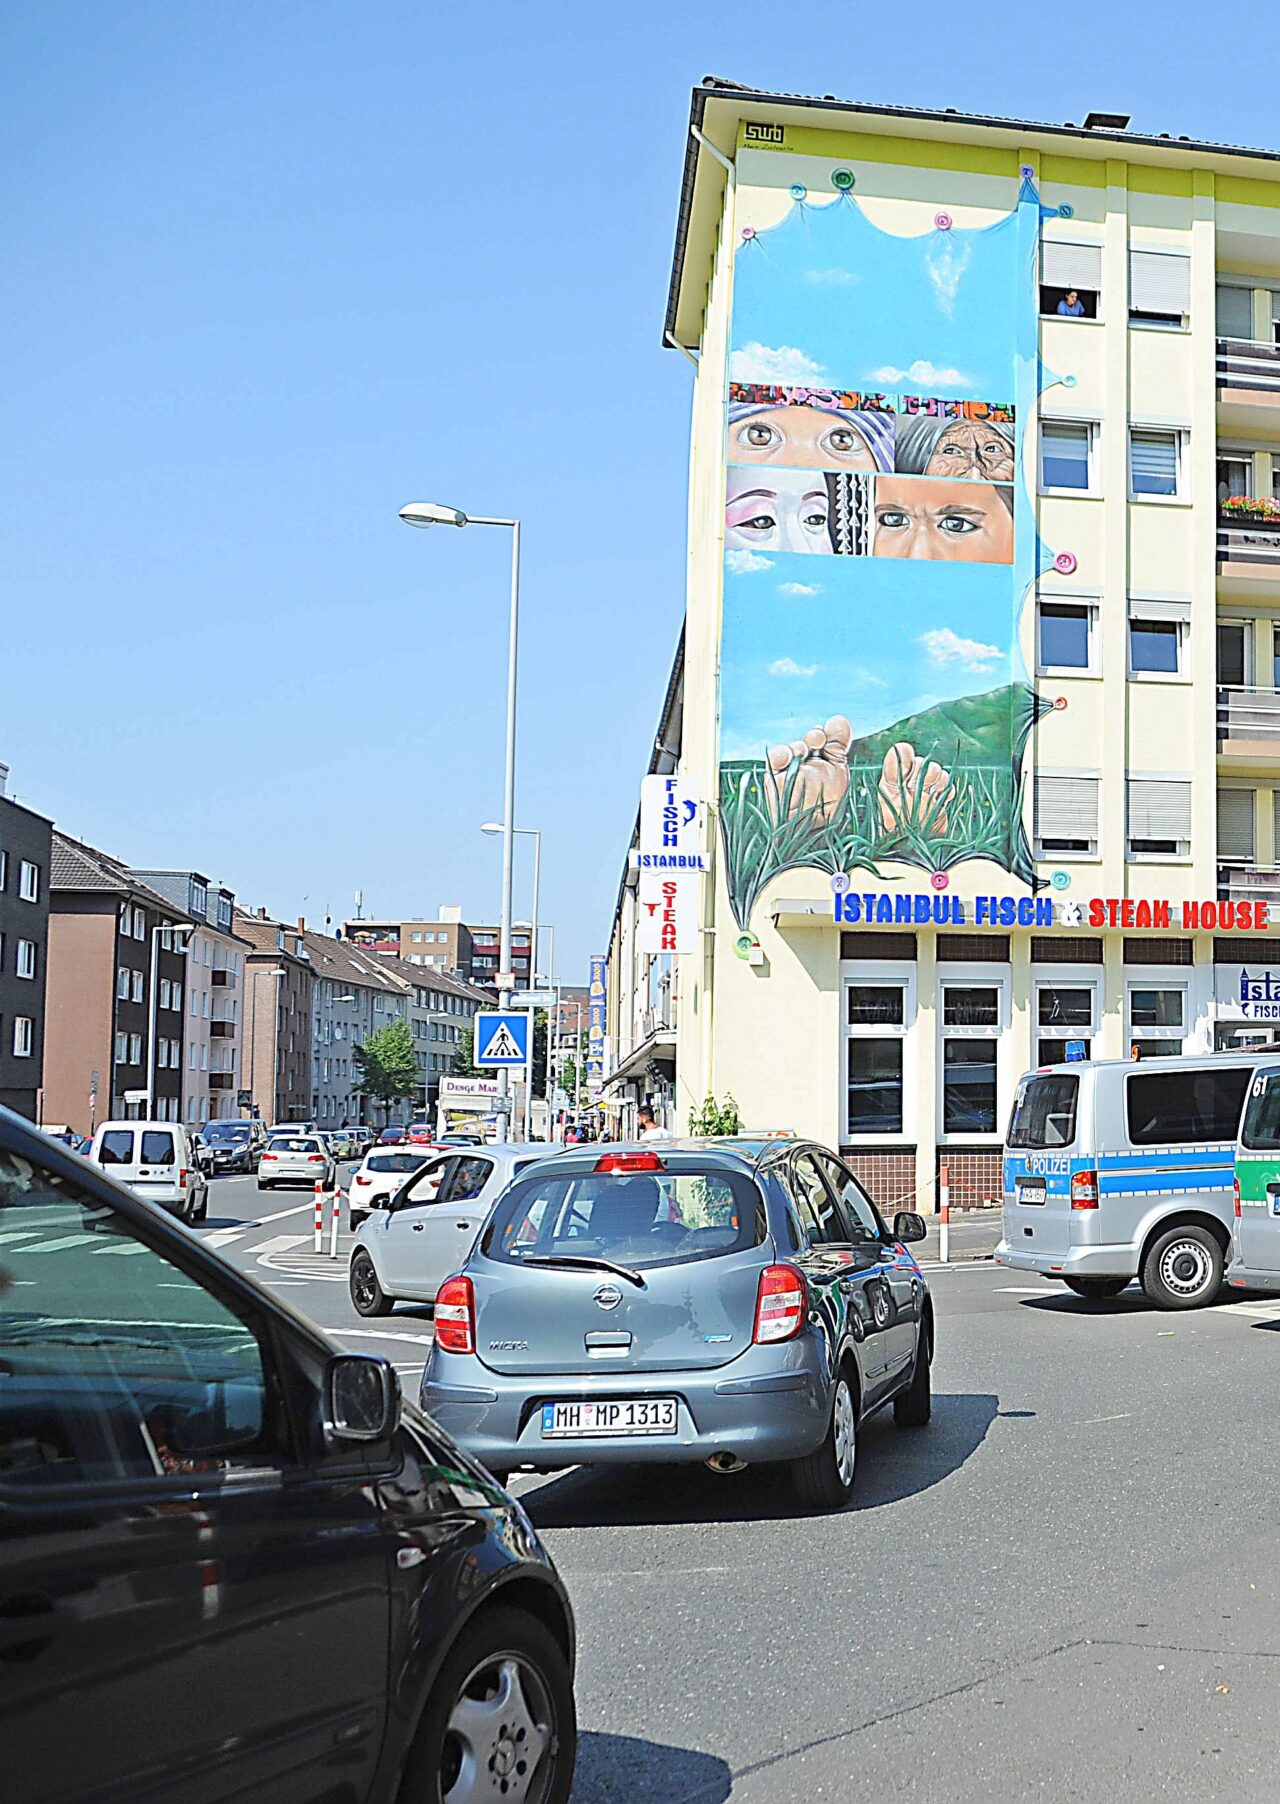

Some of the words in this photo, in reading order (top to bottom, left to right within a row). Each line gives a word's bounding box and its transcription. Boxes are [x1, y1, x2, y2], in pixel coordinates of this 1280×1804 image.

[663, 779, 678, 847] FISCH
[637, 854, 704, 869] ISTANBUL
[661, 881, 678, 950] STEAK
[975, 895, 1052, 927] FISCH
[1088, 898, 1171, 929] STEAK
[1182, 901, 1269, 930] HOUSE
[1252, 1075, 1269, 1097] 61
[1032, 1158, 1071, 1176] POLIZEI
[489, 1340, 530, 1351] MICRA
[556, 1407, 581, 1427] MH
[595, 1405, 620, 1426] MP
[625, 1404, 673, 1425] 1313
